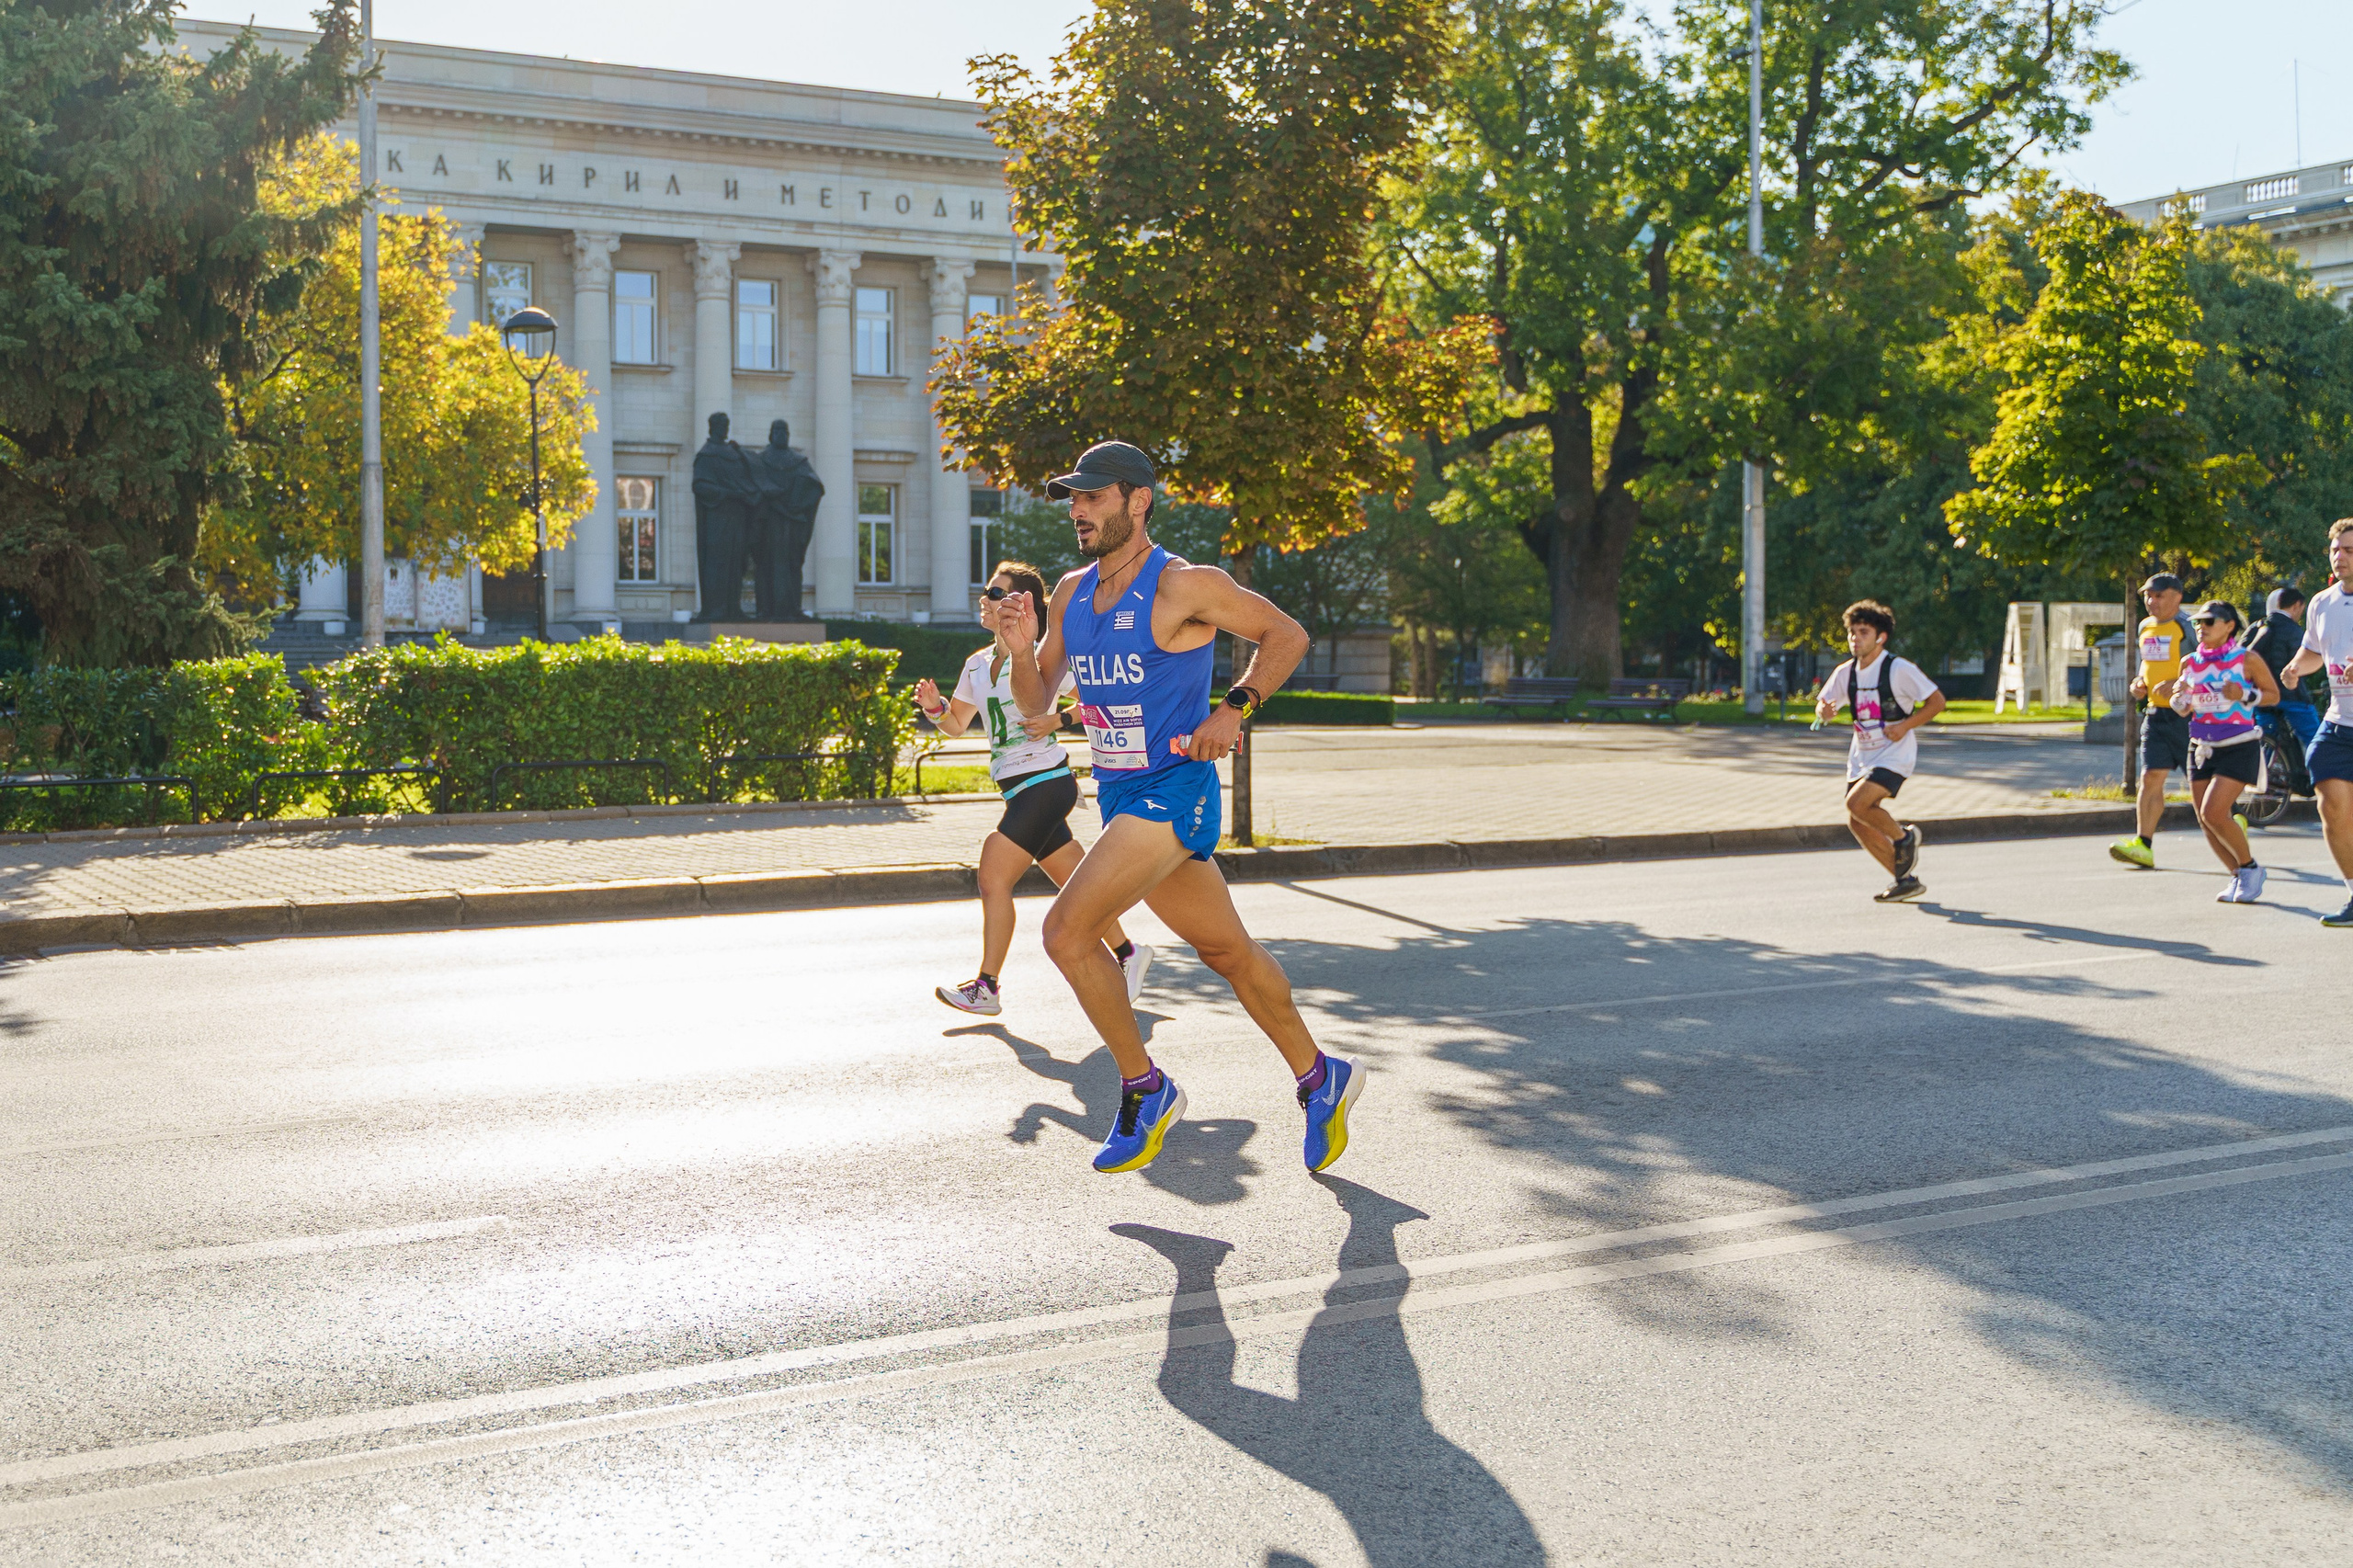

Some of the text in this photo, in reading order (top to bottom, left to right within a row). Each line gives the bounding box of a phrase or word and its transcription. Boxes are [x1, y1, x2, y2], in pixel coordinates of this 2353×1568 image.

[387, 150, 449, 176] КА
[497, 159, 681, 196] КИРИЛ
[723, 179, 739, 200] И
[1094, 729, 1129, 748] 1146
[1127, 1074, 1152, 1085] SPORT
